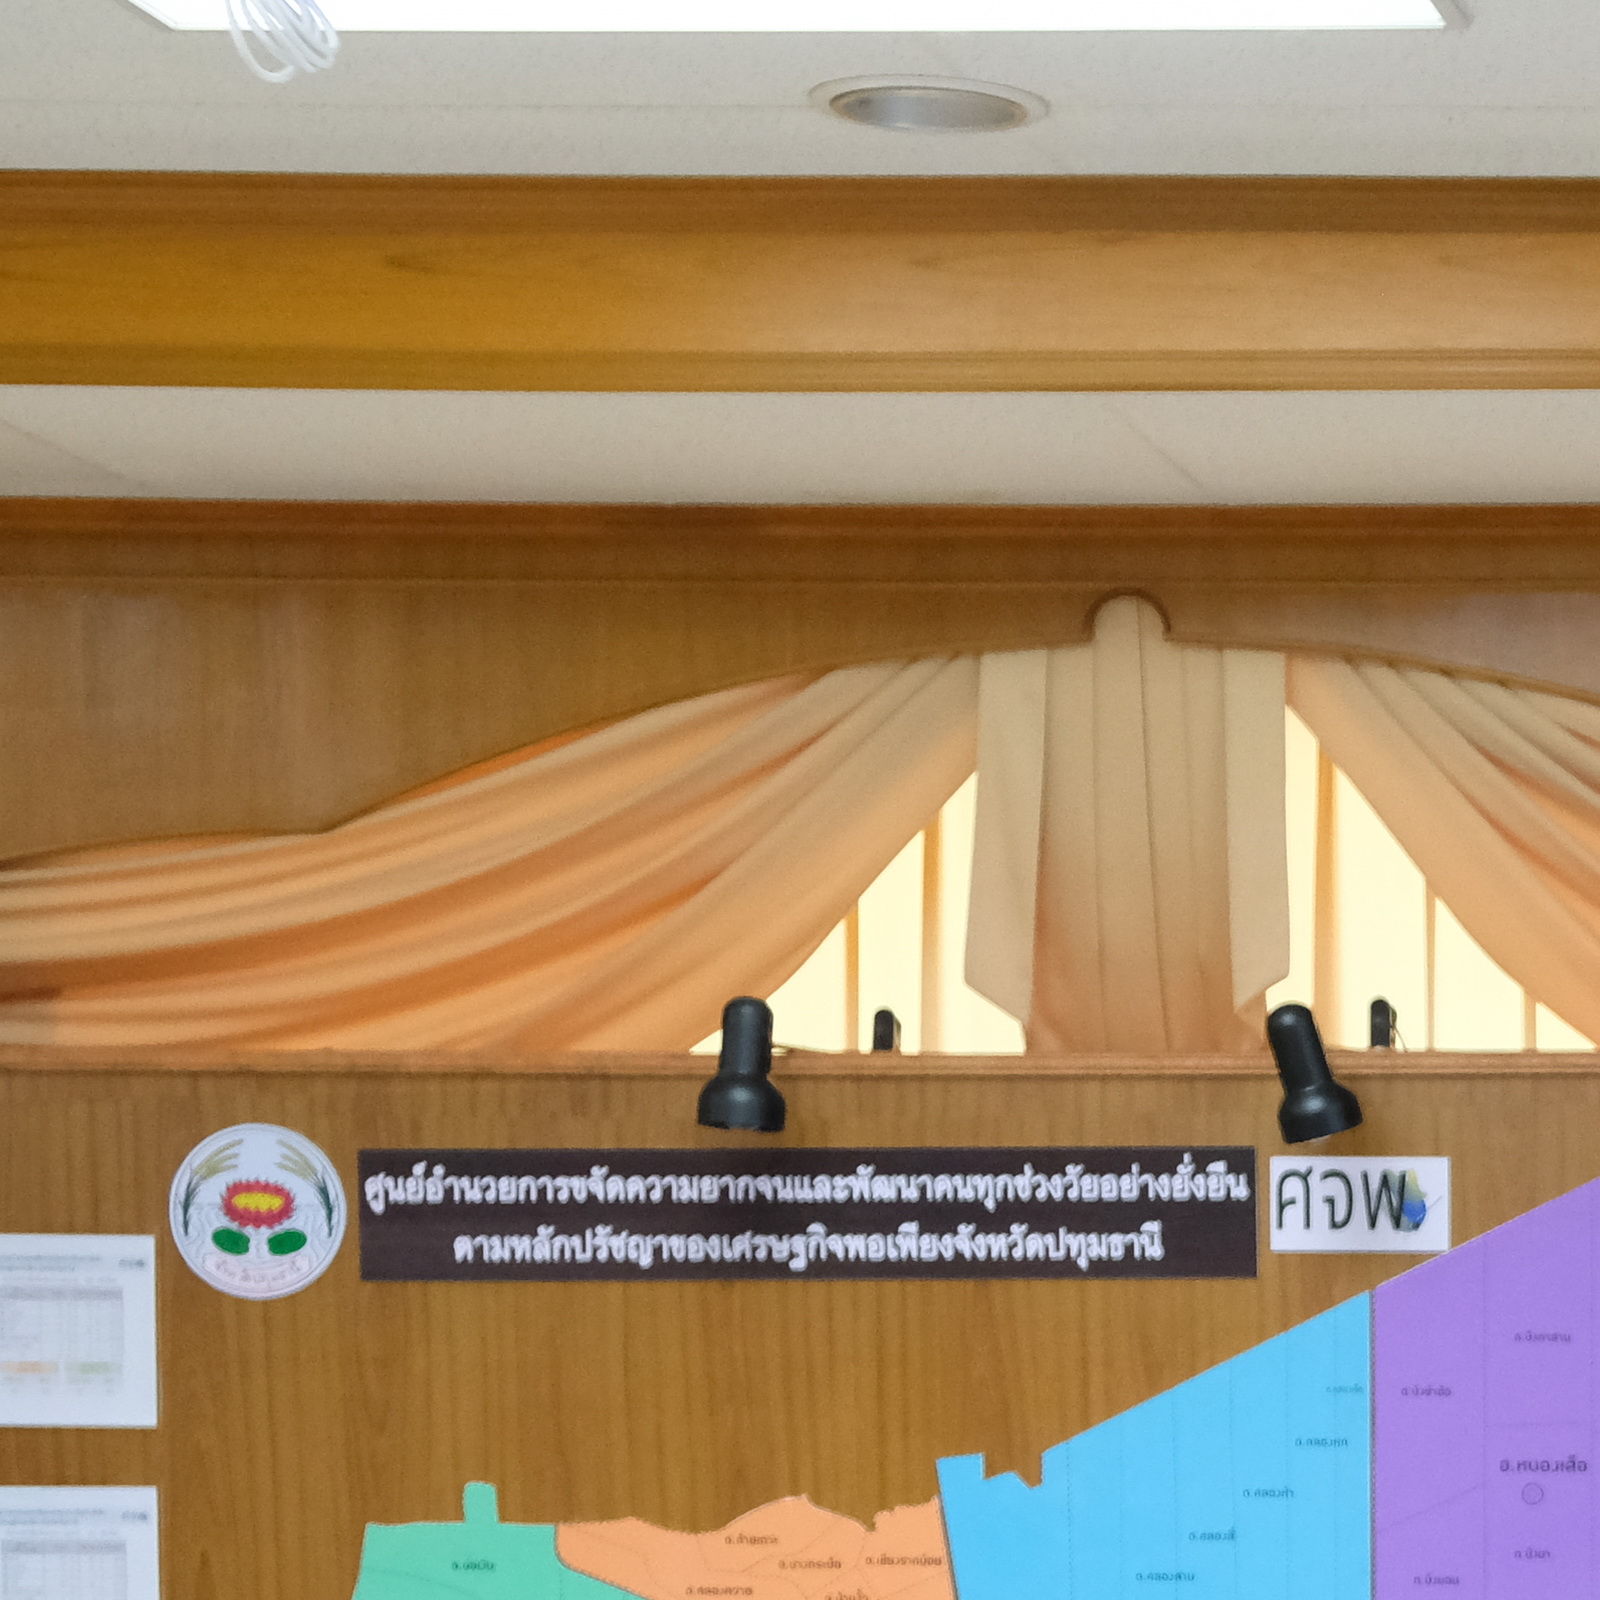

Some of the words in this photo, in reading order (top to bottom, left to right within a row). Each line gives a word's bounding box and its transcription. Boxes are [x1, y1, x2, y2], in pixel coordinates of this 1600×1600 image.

[364, 1153, 1250, 1215] ศูนย์อำนวยการขจัดความยากจนและพัฒนาคนทุกช่วงวัยอย่างยั่งยืน
[1275, 1166, 1407, 1232] ศจพ
[453, 1220, 1165, 1272] ตามหลักปรัชญาของเศรษฐกิจพอเพียงจังหวัดปทุมธานี
[1500, 1454, 1587, 1472] อ.หนองเสือ
